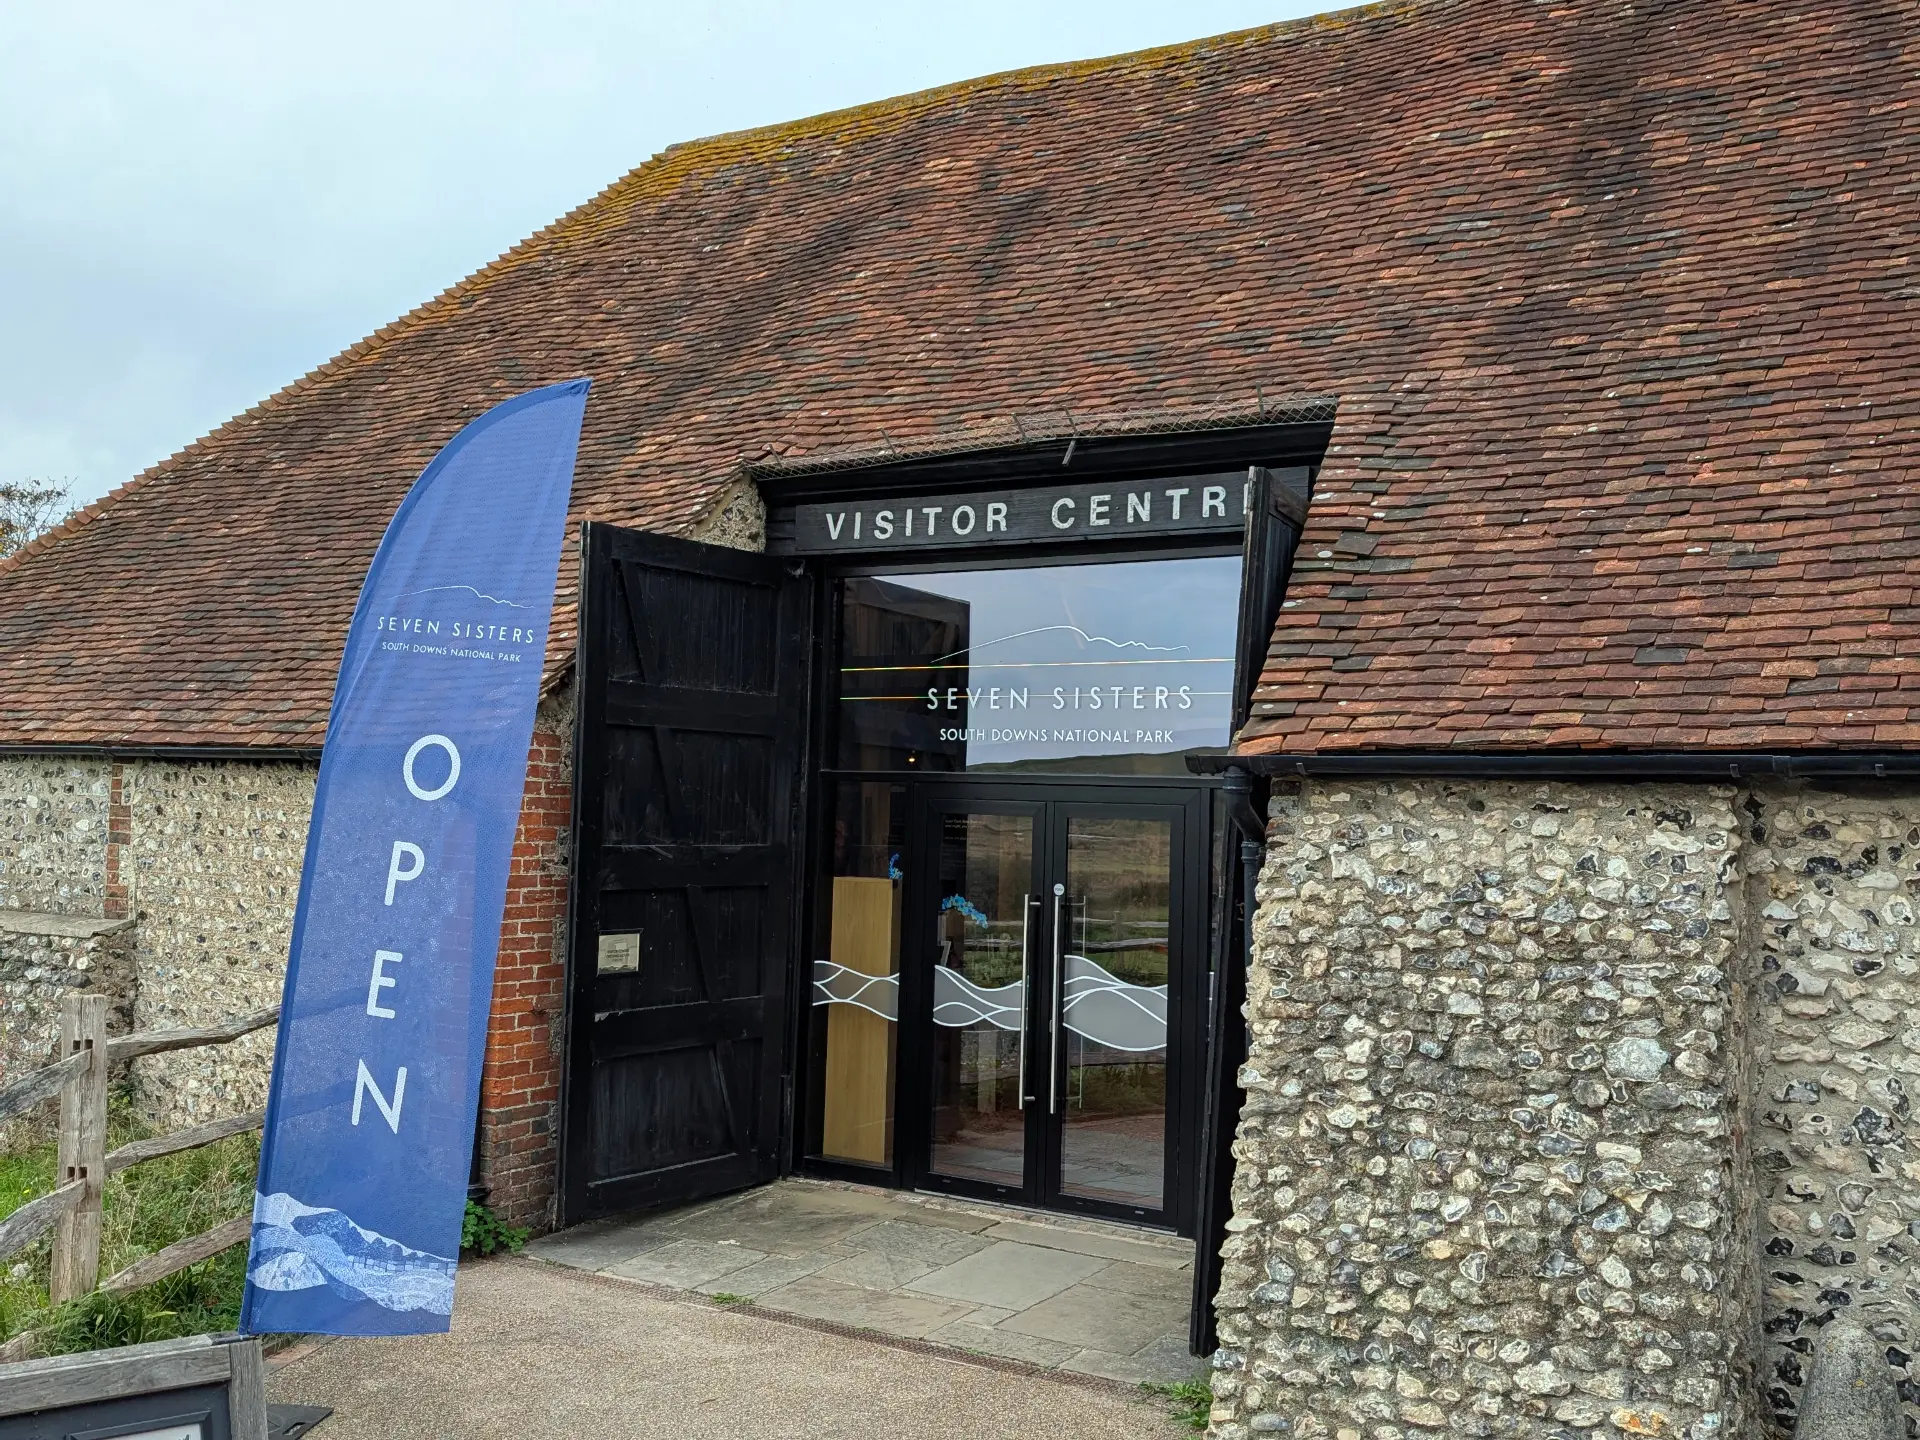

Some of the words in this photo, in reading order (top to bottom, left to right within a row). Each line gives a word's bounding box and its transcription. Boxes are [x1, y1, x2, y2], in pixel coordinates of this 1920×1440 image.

[825, 502, 1008, 540] VISITOR
[1051, 483, 1249, 530] CENTR
[377, 616, 440, 635] SEVEN
[452, 622, 534, 644] SISTERS
[382, 641, 410, 652] SOUTH
[412, 644, 447, 655] DOWNS
[450, 648, 495, 661] NATIONAL
[498, 652, 521, 663] PARK
[926, 687, 1028, 710] SEVEN
[1052, 685, 1192, 710] SISTERS
[939, 728, 985, 741] SOUTH
[991, 728, 1048, 742] DOWNS
[1053, 729, 1130, 743] NATIONAL
[1135, 729, 1174, 743] PARK
[351, 734, 461, 1135] OPEN
